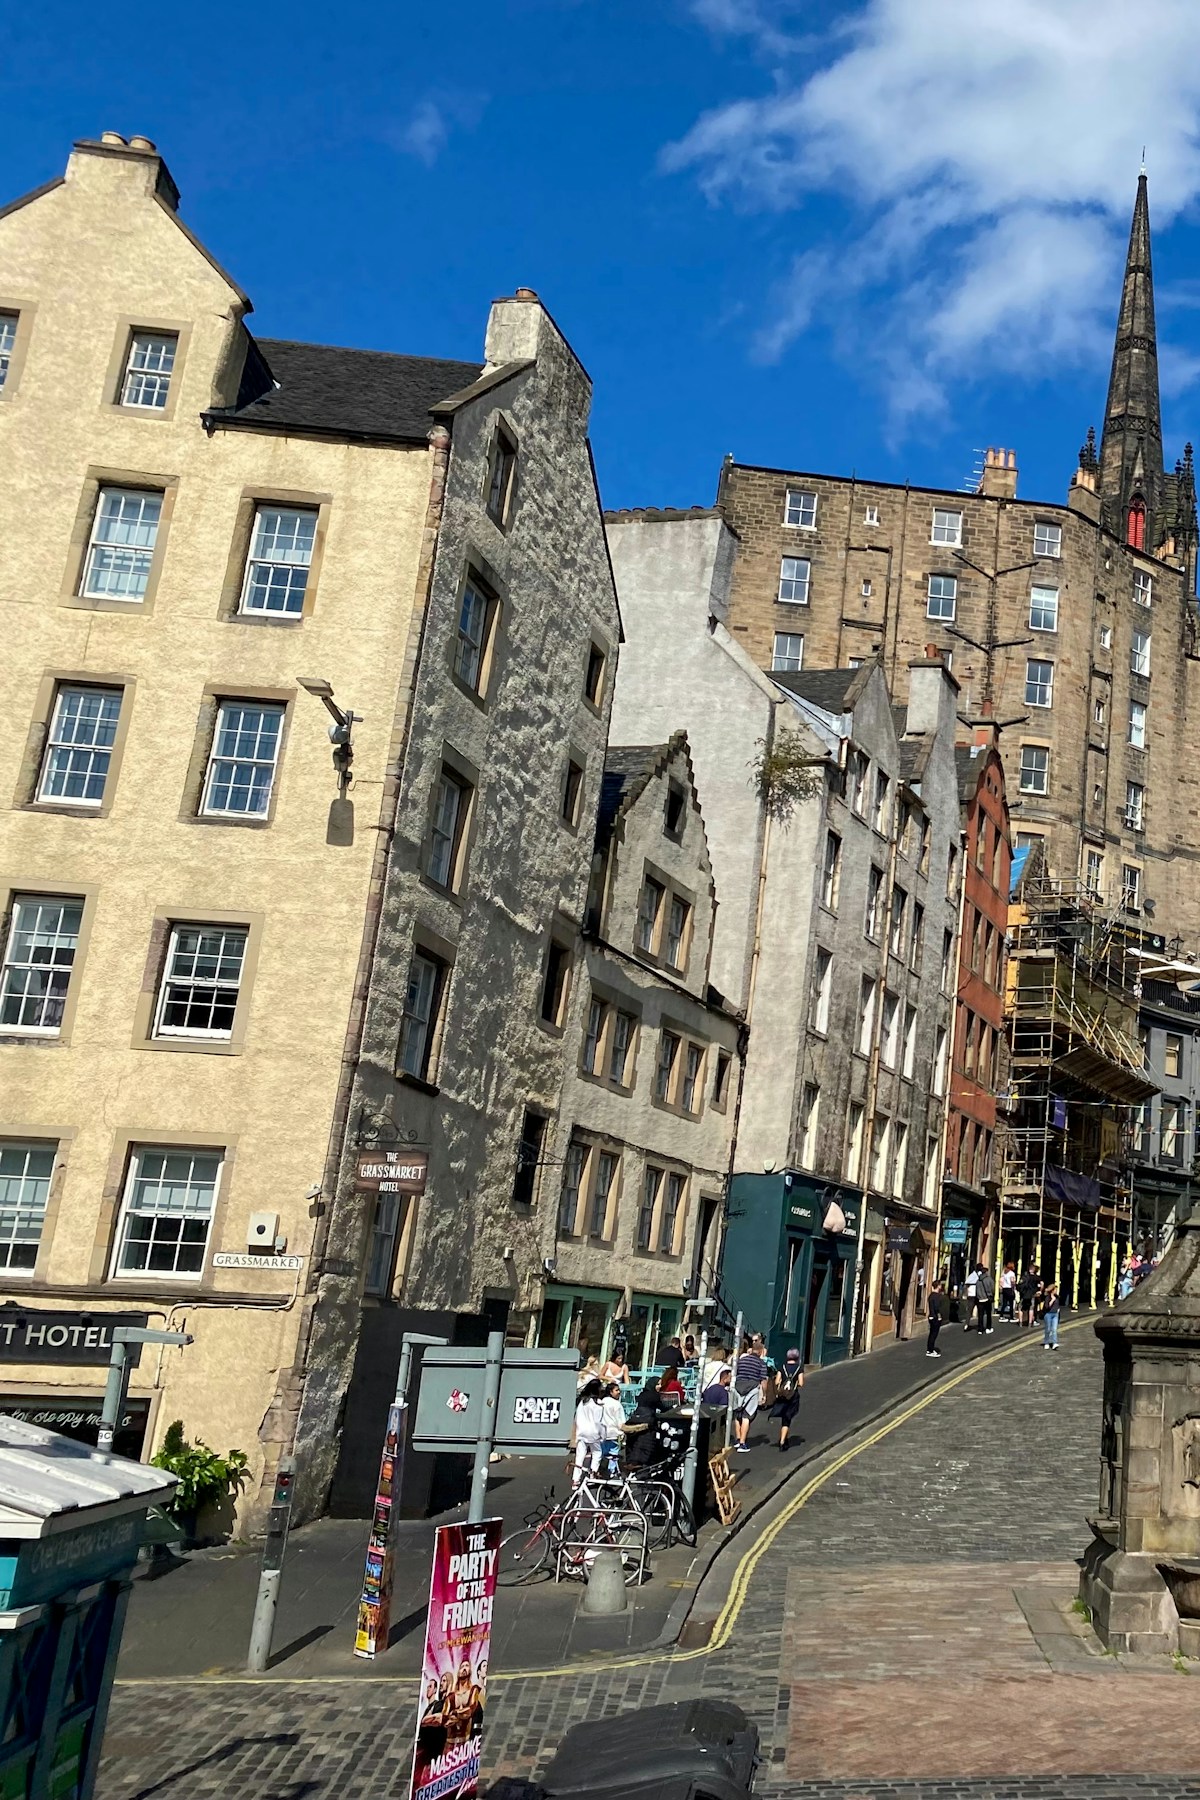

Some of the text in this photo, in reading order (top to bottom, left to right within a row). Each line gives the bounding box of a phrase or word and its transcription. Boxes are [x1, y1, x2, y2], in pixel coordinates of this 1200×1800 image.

[386, 1152, 399, 1162] THE
[361, 1164, 426, 1179] GRASSMARKET
[379, 1181, 399, 1192] HOTEL
[216, 1255, 300, 1267] GRASSMARKET
[25, 1324, 111, 1348] HOTEL
[515, 1397, 560, 1411] DON'T
[513, 1409, 560, 1423] SLEEP
[448, 1549, 497, 1583] PARTY
[456, 1580, 487, 1600] OF THE
[429, 1735, 482, 1779] MASSAOKE
